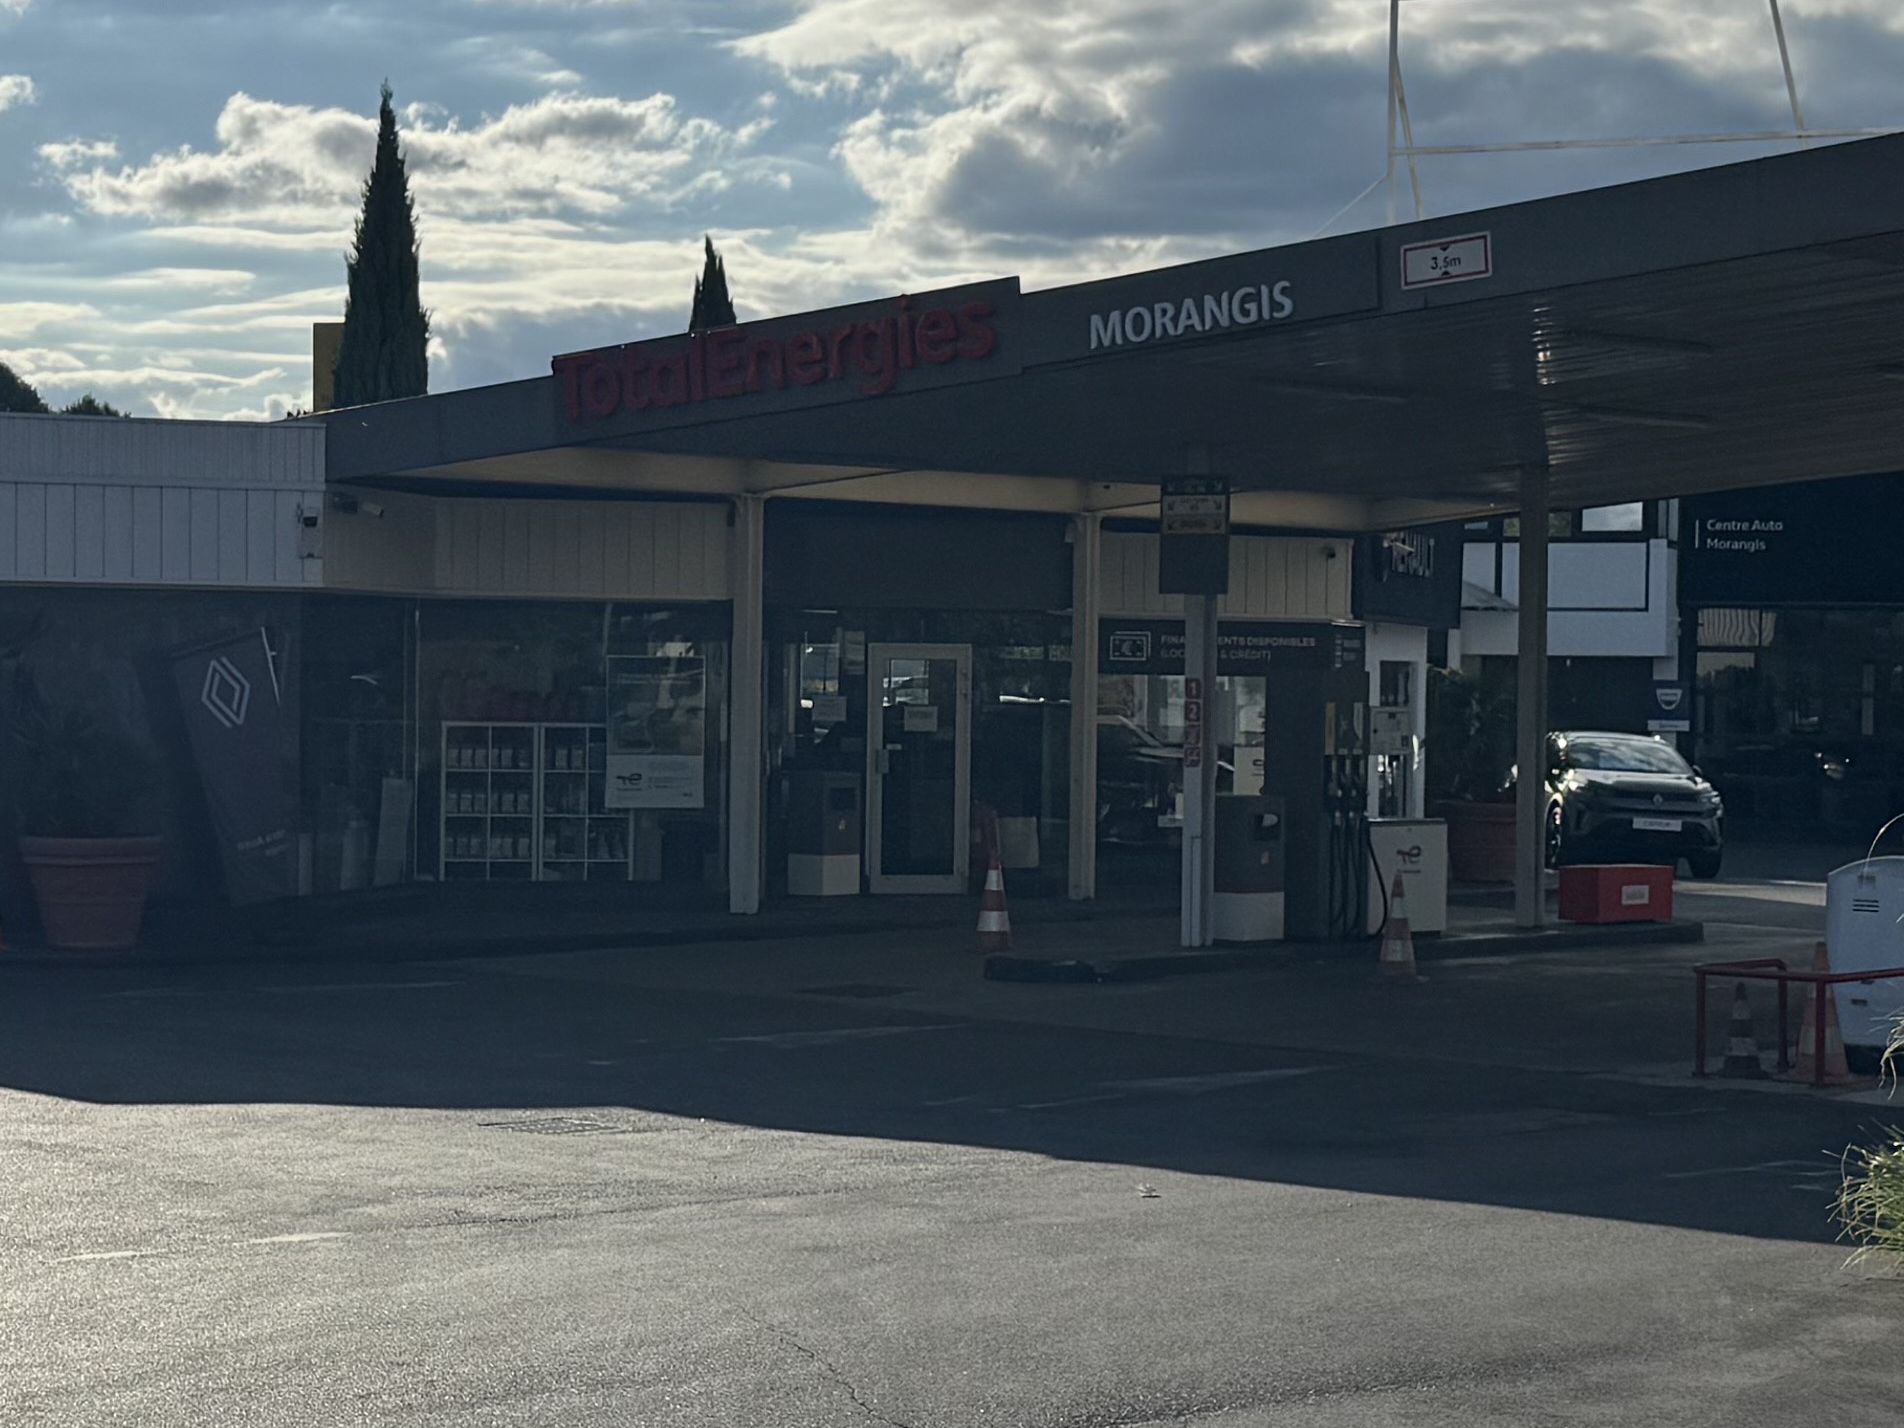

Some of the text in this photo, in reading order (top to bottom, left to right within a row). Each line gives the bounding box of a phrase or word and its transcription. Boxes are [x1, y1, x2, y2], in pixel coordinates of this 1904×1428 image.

[1430, 256, 1462, 270] 3,5m
[1089, 280, 1294, 350] MORANGIS
[563, 294, 996, 422] TotalEnergies
[1706, 518, 1784, 532] Centre Auto
[1706, 537, 1767, 553] Morangis
